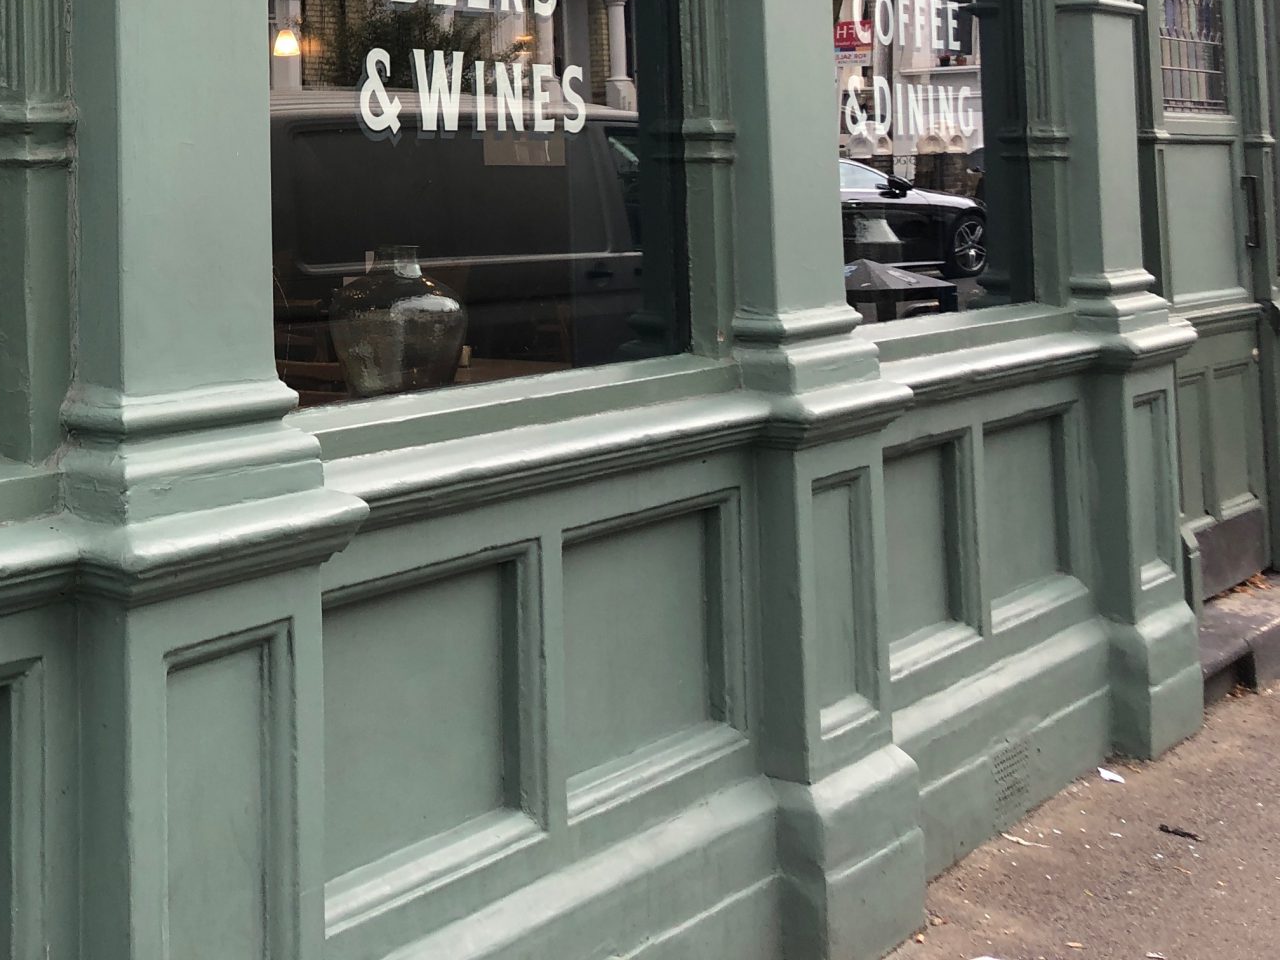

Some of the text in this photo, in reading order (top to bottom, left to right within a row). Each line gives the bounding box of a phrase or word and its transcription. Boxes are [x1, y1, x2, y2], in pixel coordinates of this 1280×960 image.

[360, 48, 587, 134] & WINES
[845, 75, 975, 142] & DINING
